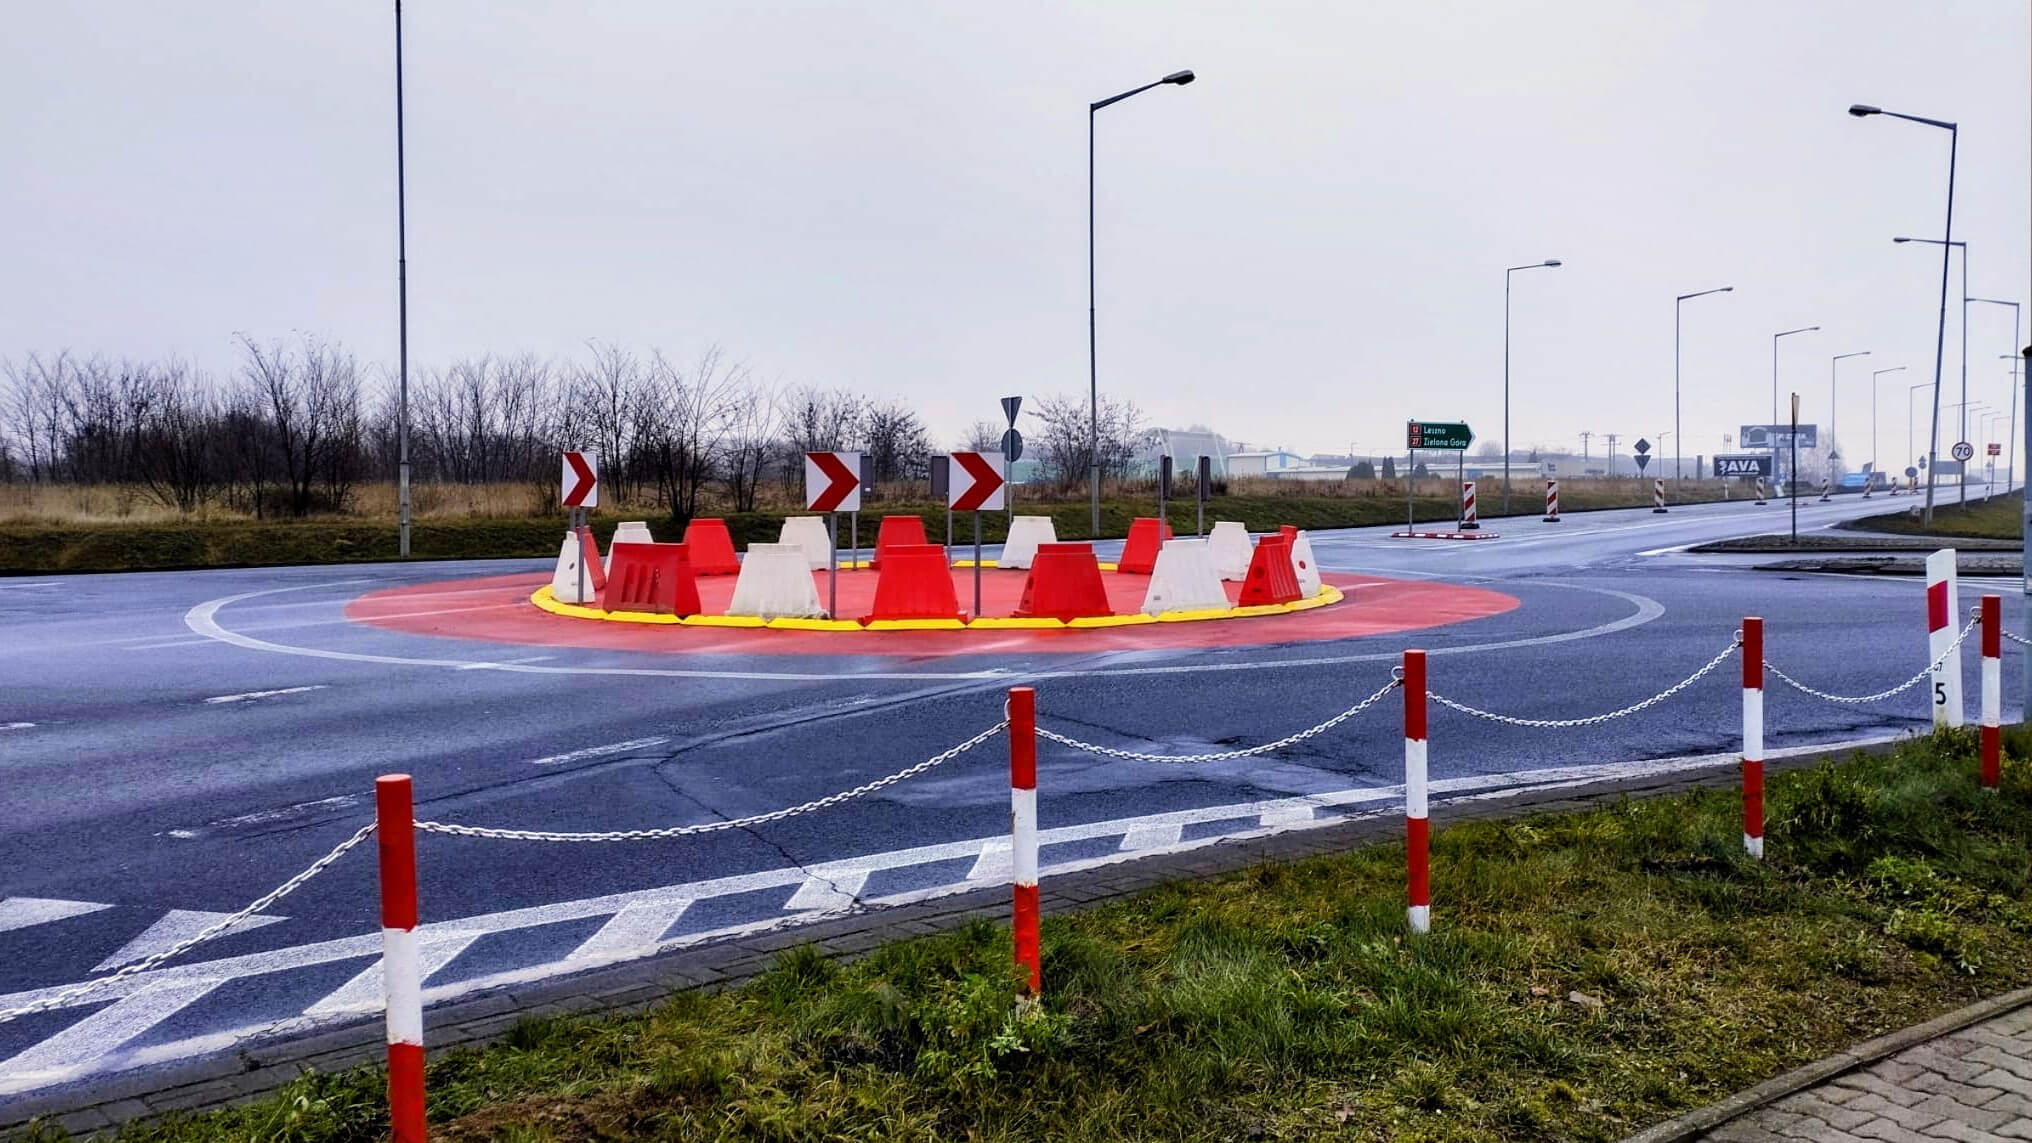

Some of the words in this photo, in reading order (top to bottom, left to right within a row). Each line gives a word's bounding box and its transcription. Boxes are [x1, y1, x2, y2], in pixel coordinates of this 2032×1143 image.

[1423, 426, 1446, 434] Leszno
[1423, 437, 1448, 446] Zielona
[1956, 447, 1970, 457] 70
[1936, 682, 1947, 705] 5
